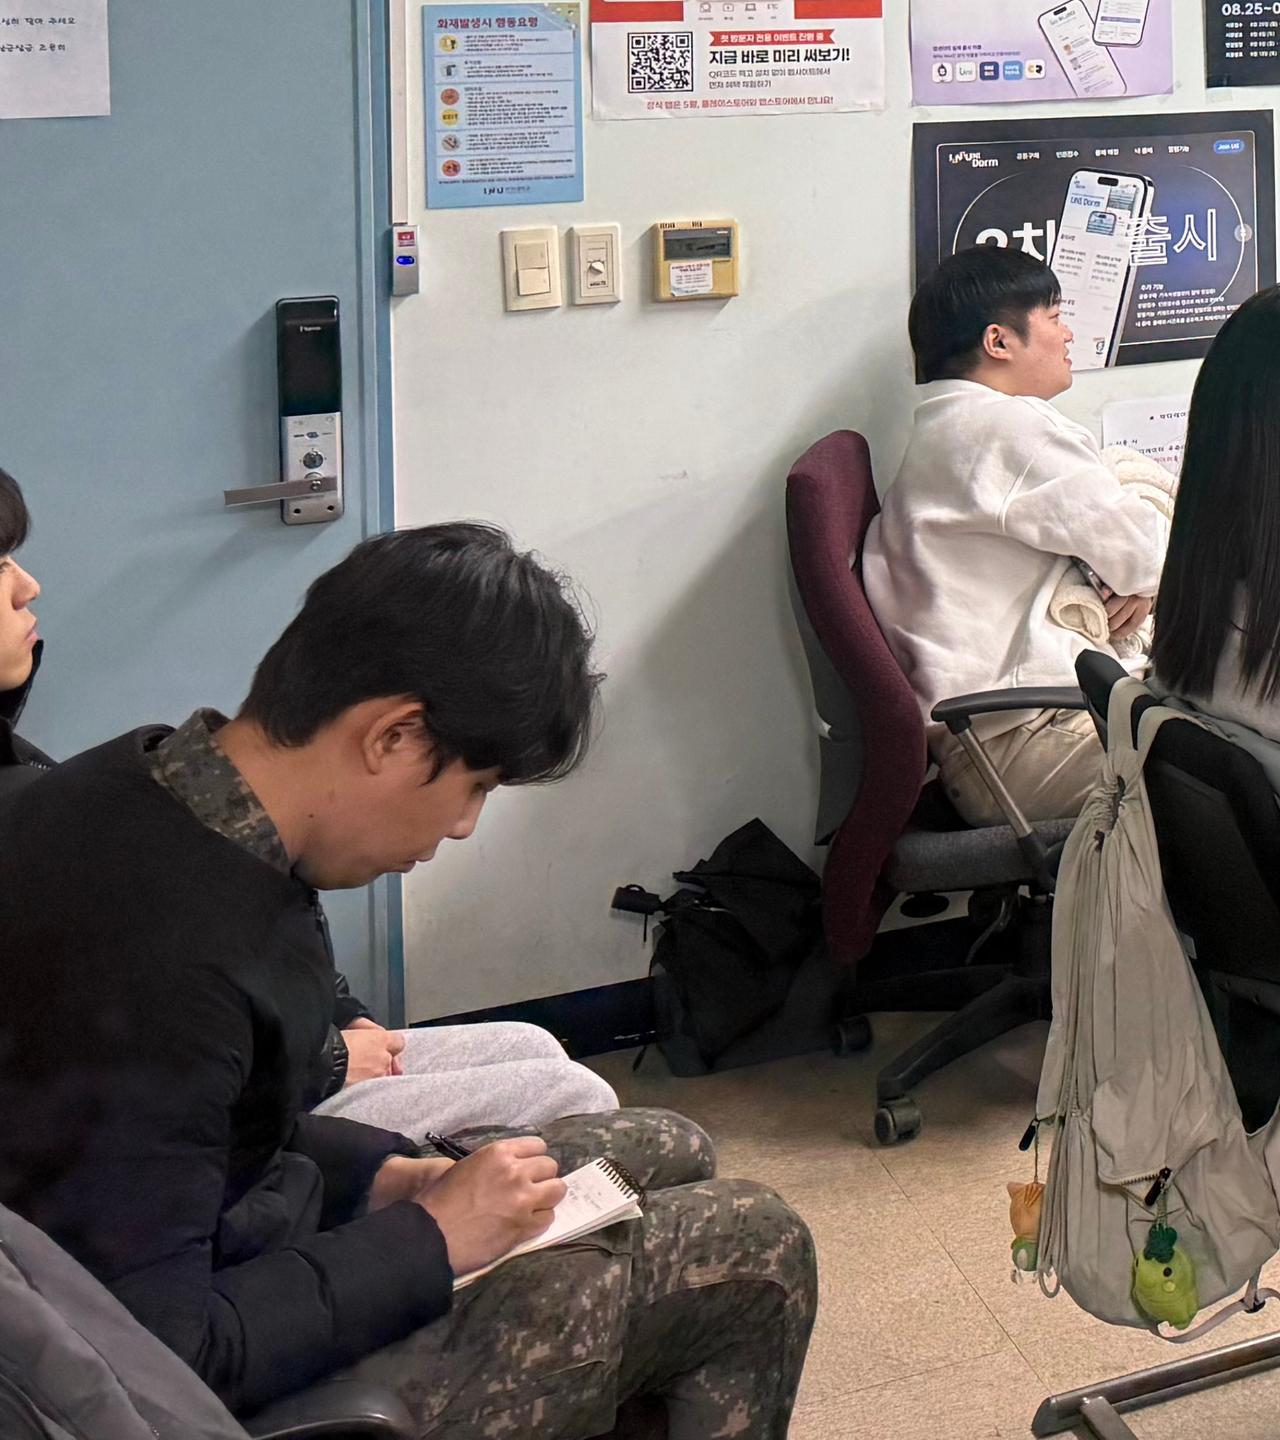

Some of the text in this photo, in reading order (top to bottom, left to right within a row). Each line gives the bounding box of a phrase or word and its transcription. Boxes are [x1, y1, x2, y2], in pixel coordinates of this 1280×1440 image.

[437, 16, 538, 29] 화재발생시 행동요령
[709, 48, 850, 64] 지금 바로 미리 써보기!
[972, 158, 998, 167] Dorm
[1129, 208, 1217, 266] 출시
